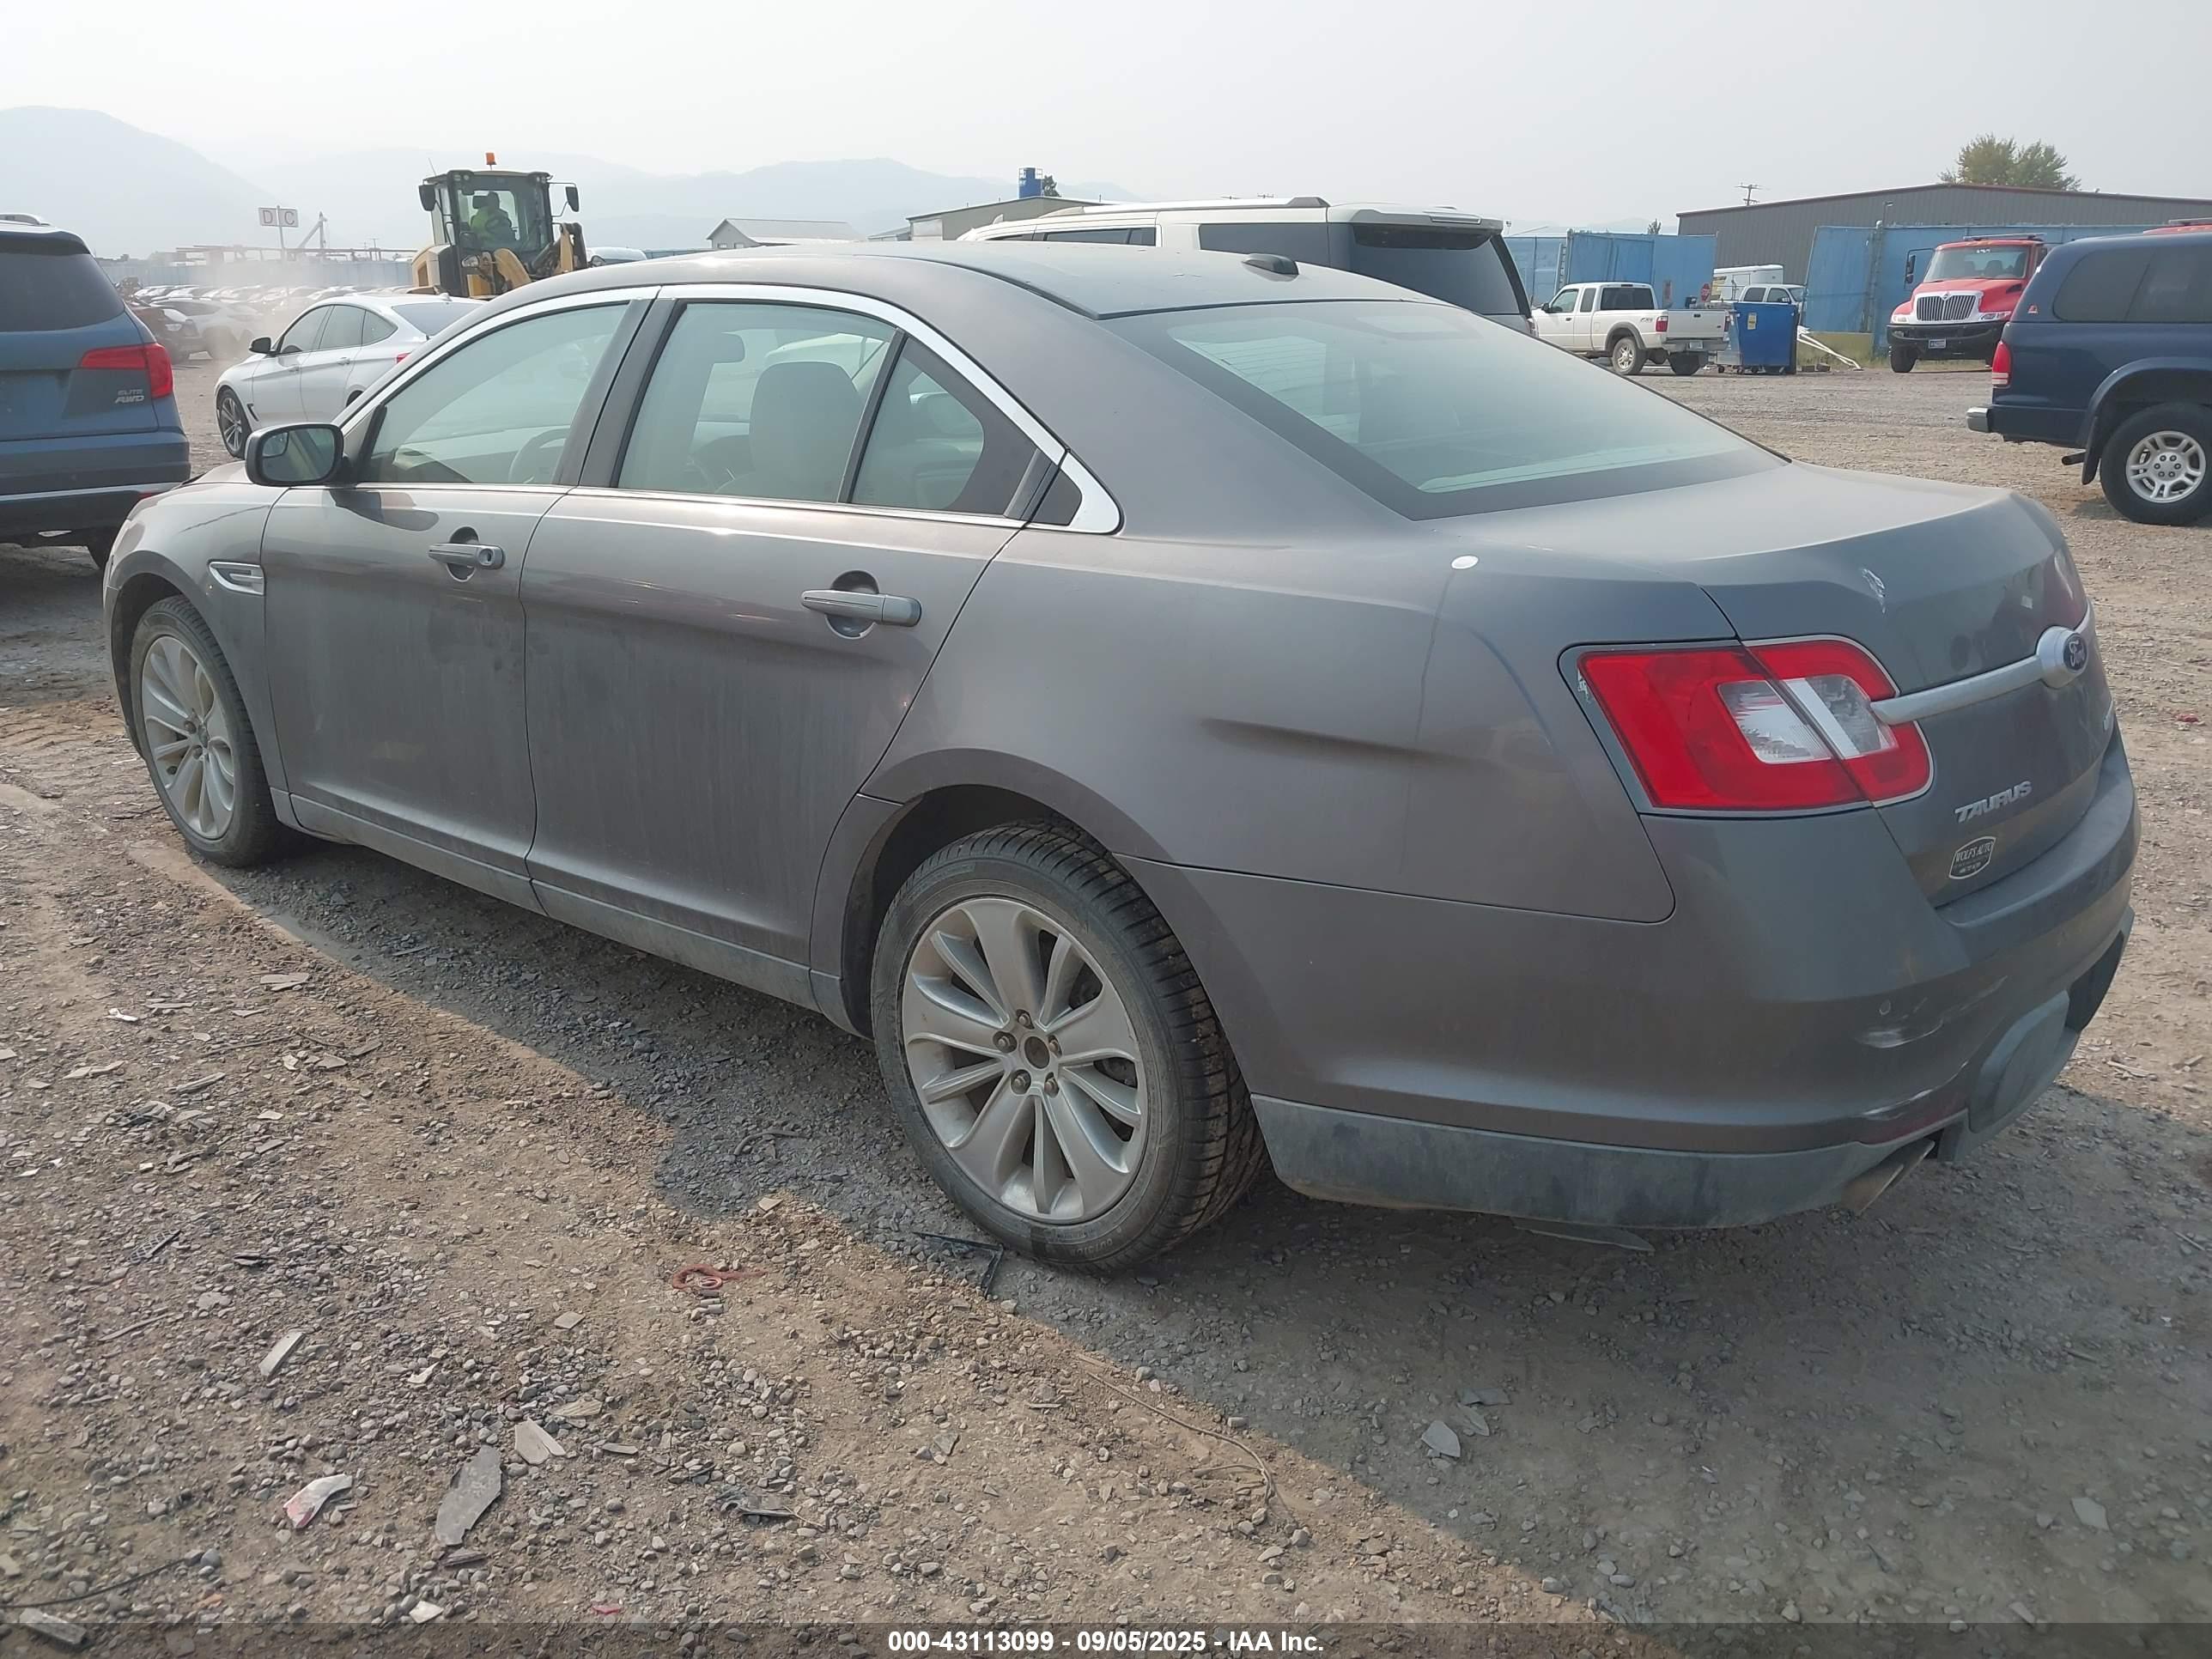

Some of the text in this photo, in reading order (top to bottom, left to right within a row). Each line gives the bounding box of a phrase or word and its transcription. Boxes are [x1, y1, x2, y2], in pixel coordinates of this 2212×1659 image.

[262, 210, 295, 226] D C
[114, 395, 145, 404] AWD
[2069, 640, 2086, 668] Ford
[1954, 781, 2033, 823] TAURUS
